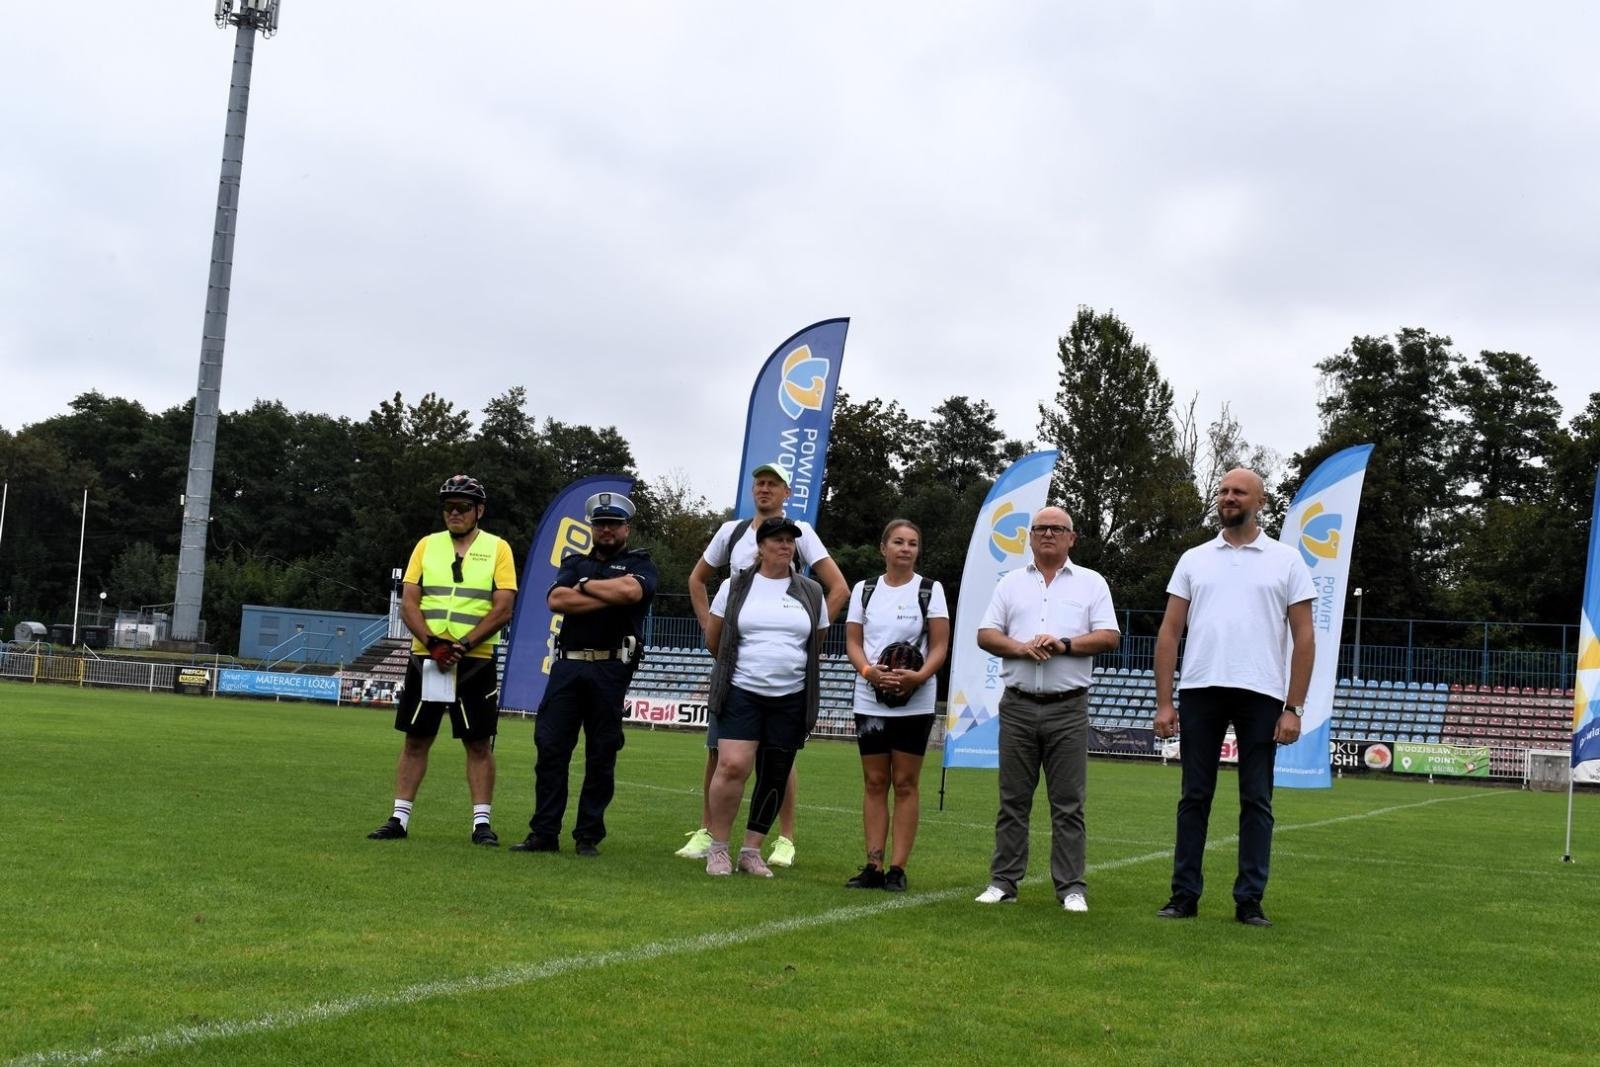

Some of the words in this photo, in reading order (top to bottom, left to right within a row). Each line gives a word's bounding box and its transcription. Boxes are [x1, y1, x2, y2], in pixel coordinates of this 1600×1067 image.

[792, 428, 818, 514] POWIAT
[1319, 576, 1336, 633] POWIAT
[255, 674, 301, 688] MATERACE
[635, 700, 675, 721] Rail
[1428, 756, 1457, 765] POINT
